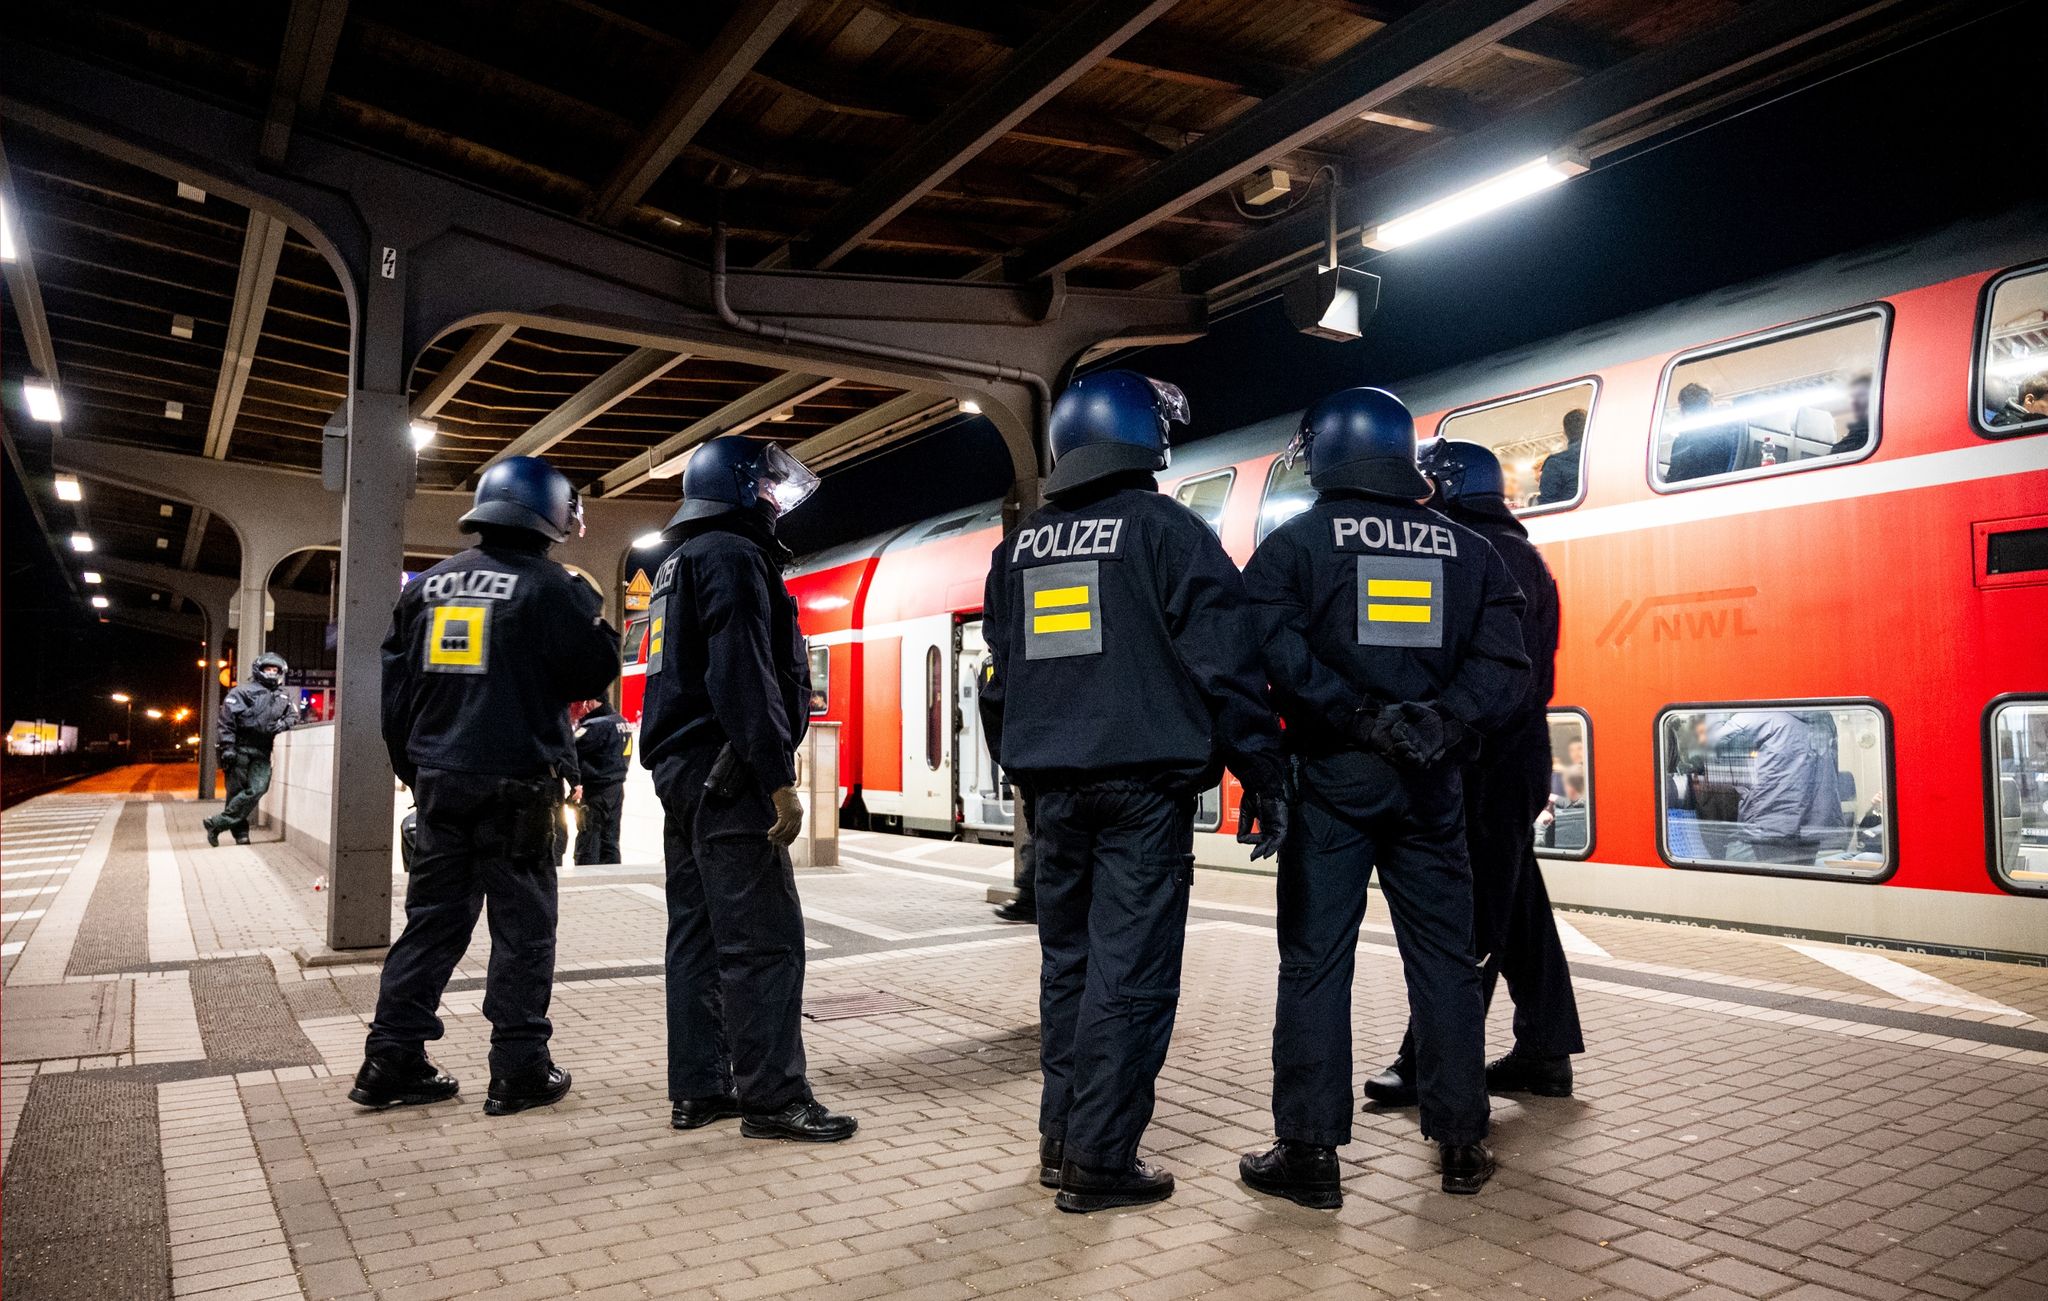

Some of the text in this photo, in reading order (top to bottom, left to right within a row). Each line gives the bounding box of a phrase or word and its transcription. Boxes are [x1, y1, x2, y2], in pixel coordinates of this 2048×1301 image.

[1012, 519, 1122, 563] POLIZEI
[1333, 517, 1457, 557] POLIZEI
[423, 570, 519, 602] POLIZEI
[1653, 608, 1757, 643] NWL
